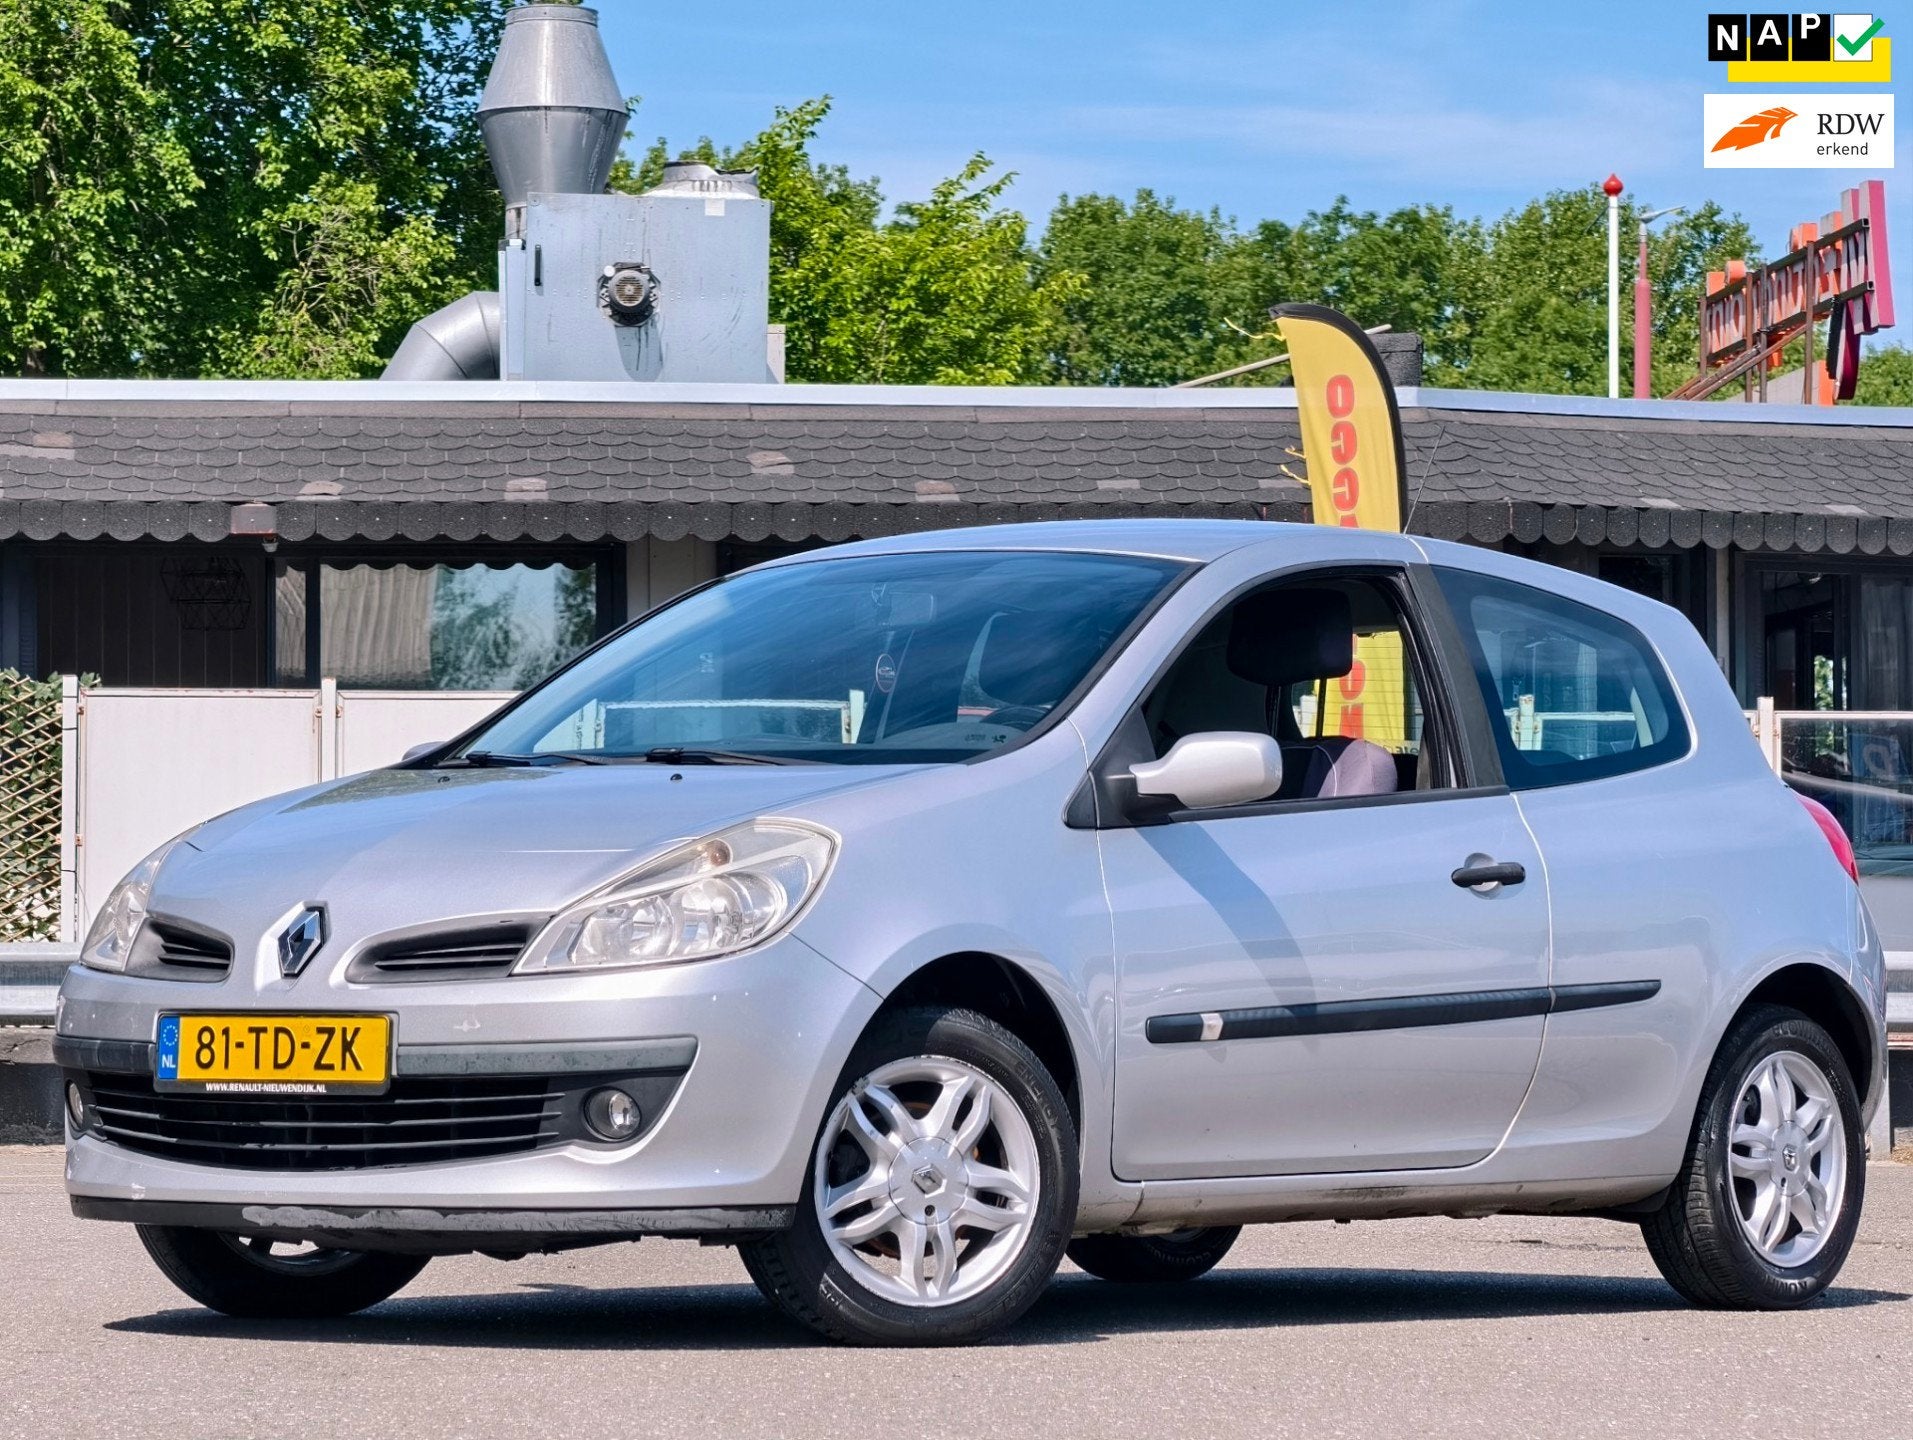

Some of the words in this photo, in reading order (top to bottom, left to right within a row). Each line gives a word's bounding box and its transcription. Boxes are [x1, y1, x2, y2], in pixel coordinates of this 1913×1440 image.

[195, 1026, 363, 1071] 81-TD-ZK
[162, 1054, 176, 1068] NL
[205, 1082, 327, 1093] WWW.RENAULT-NIEUWENDIJK.NL
